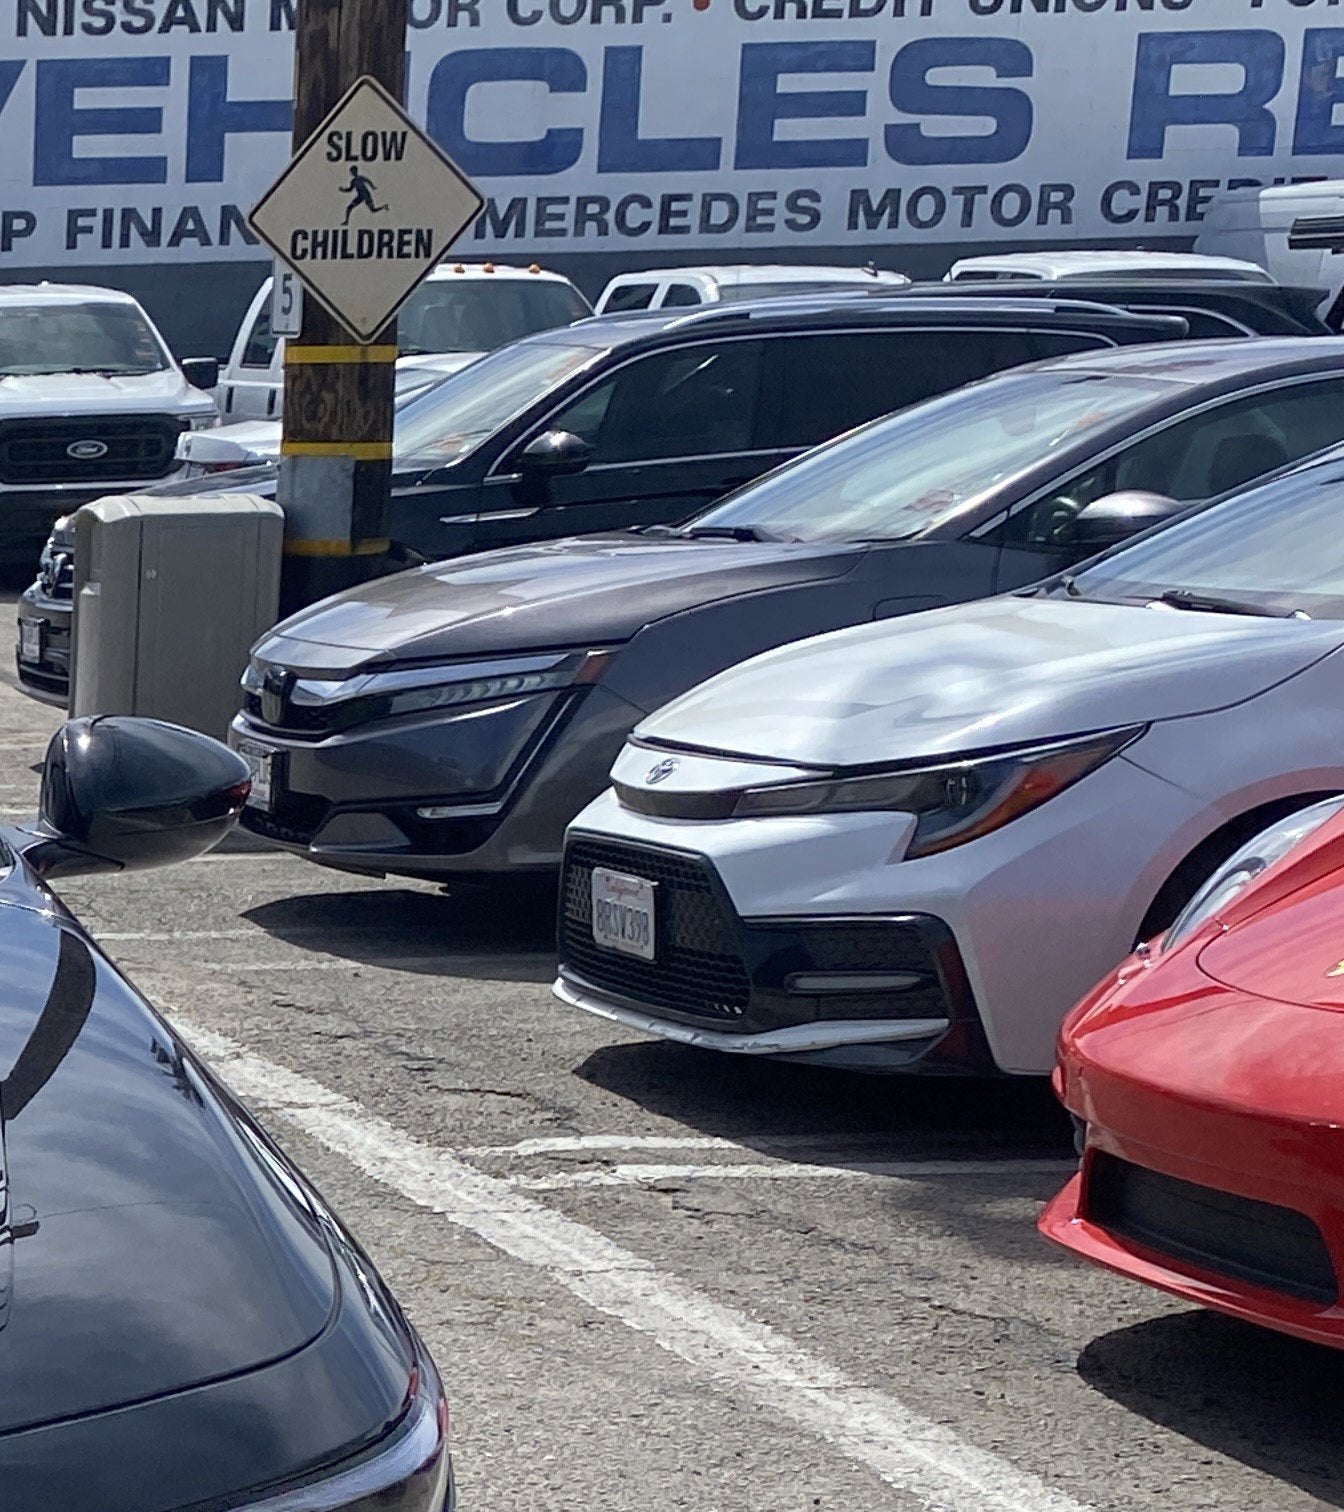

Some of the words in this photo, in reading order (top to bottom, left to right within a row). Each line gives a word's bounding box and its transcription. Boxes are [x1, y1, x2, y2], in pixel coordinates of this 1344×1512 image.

[14, 0, 245, 38] NISSAN
[325, 130, 409, 163] SLOW
[473, 190, 822, 241] MERCEDES
[845, 182, 1076, 232] MOTOR
[289, 228, 434, 261] CHILDREN
[281, 273, 294, 316] 5
